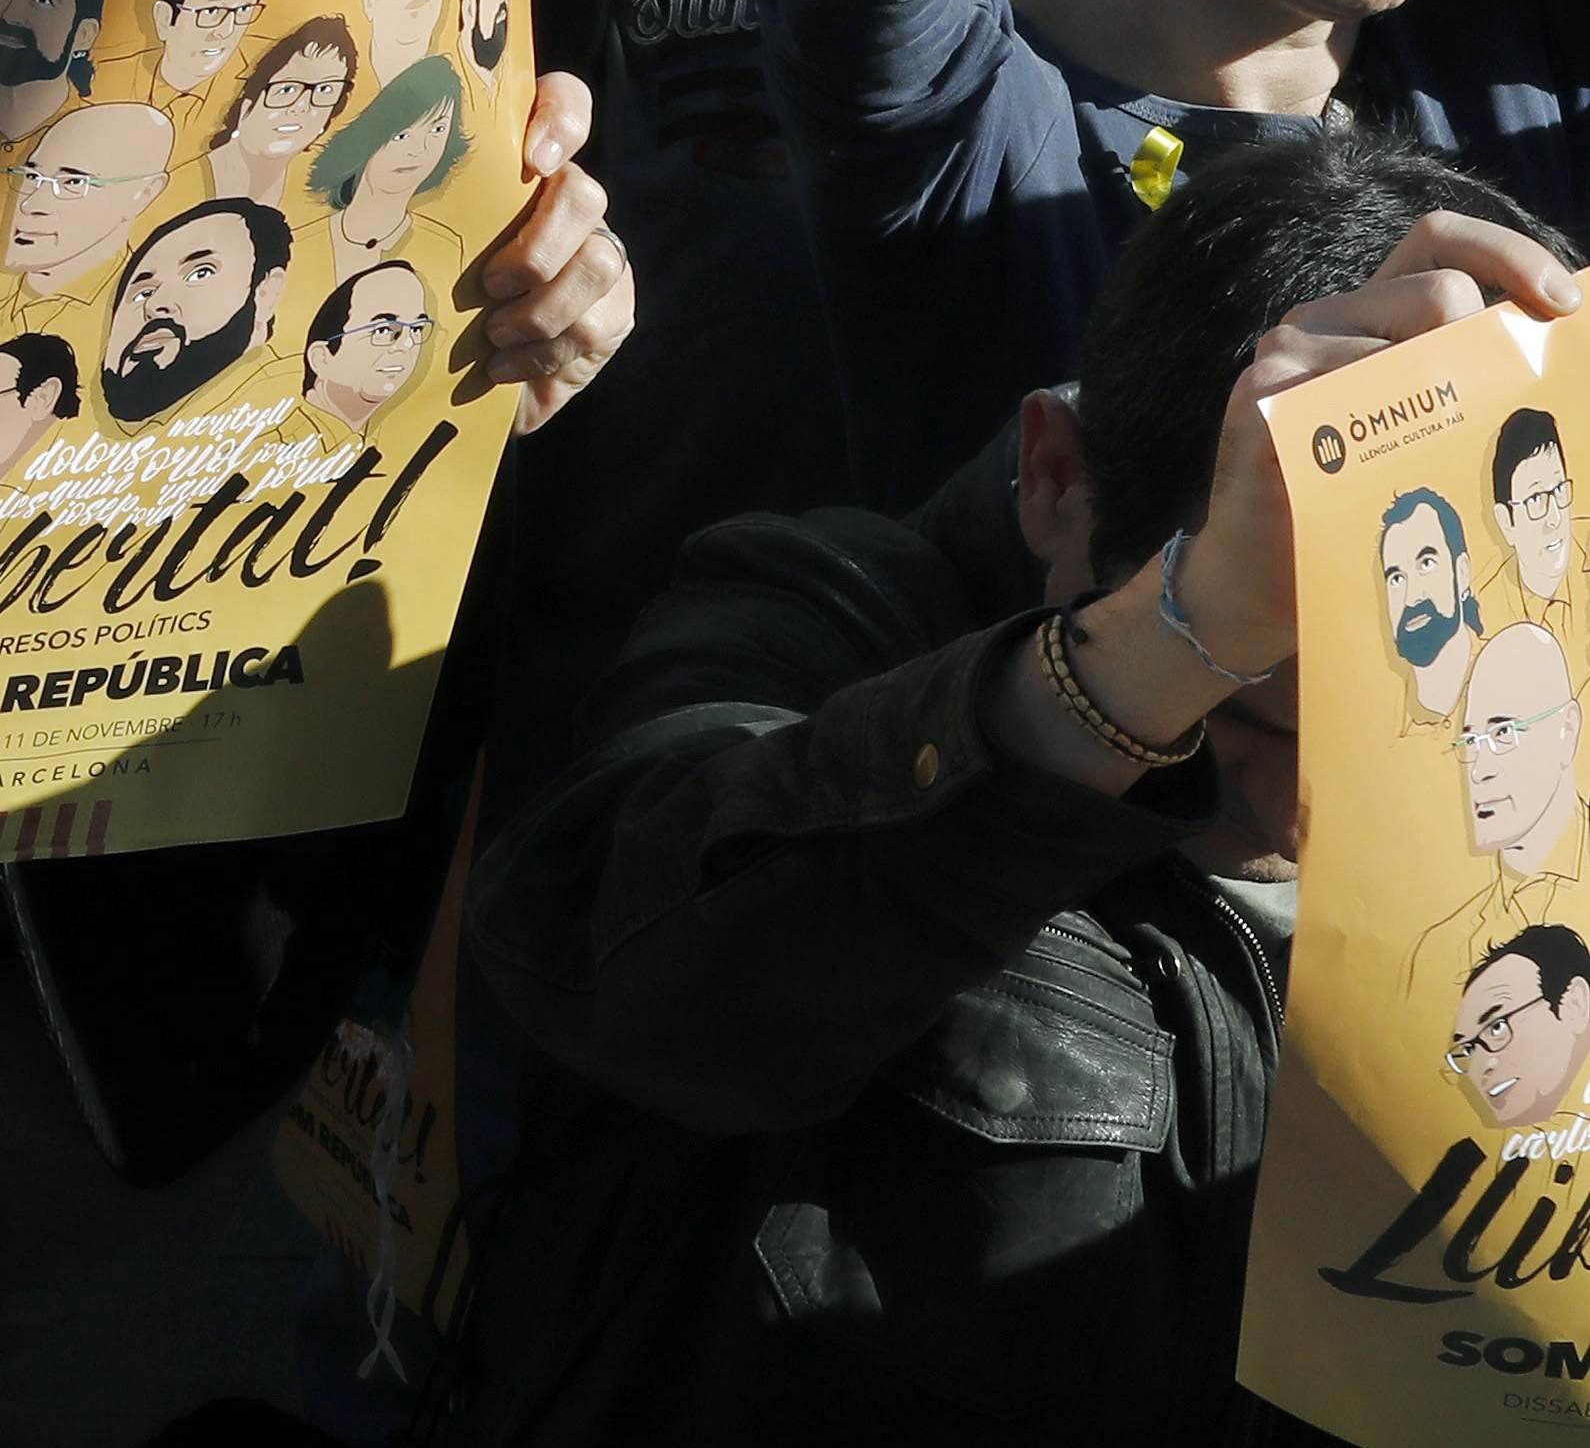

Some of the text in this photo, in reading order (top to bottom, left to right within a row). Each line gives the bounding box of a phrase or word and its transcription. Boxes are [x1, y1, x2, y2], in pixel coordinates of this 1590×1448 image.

[1348, 379, 1459, 444] ÒMNIUM
[97, 610, 211, 641] POLÍTICS
[1, 646, 304, 716] REPÚBLICA
